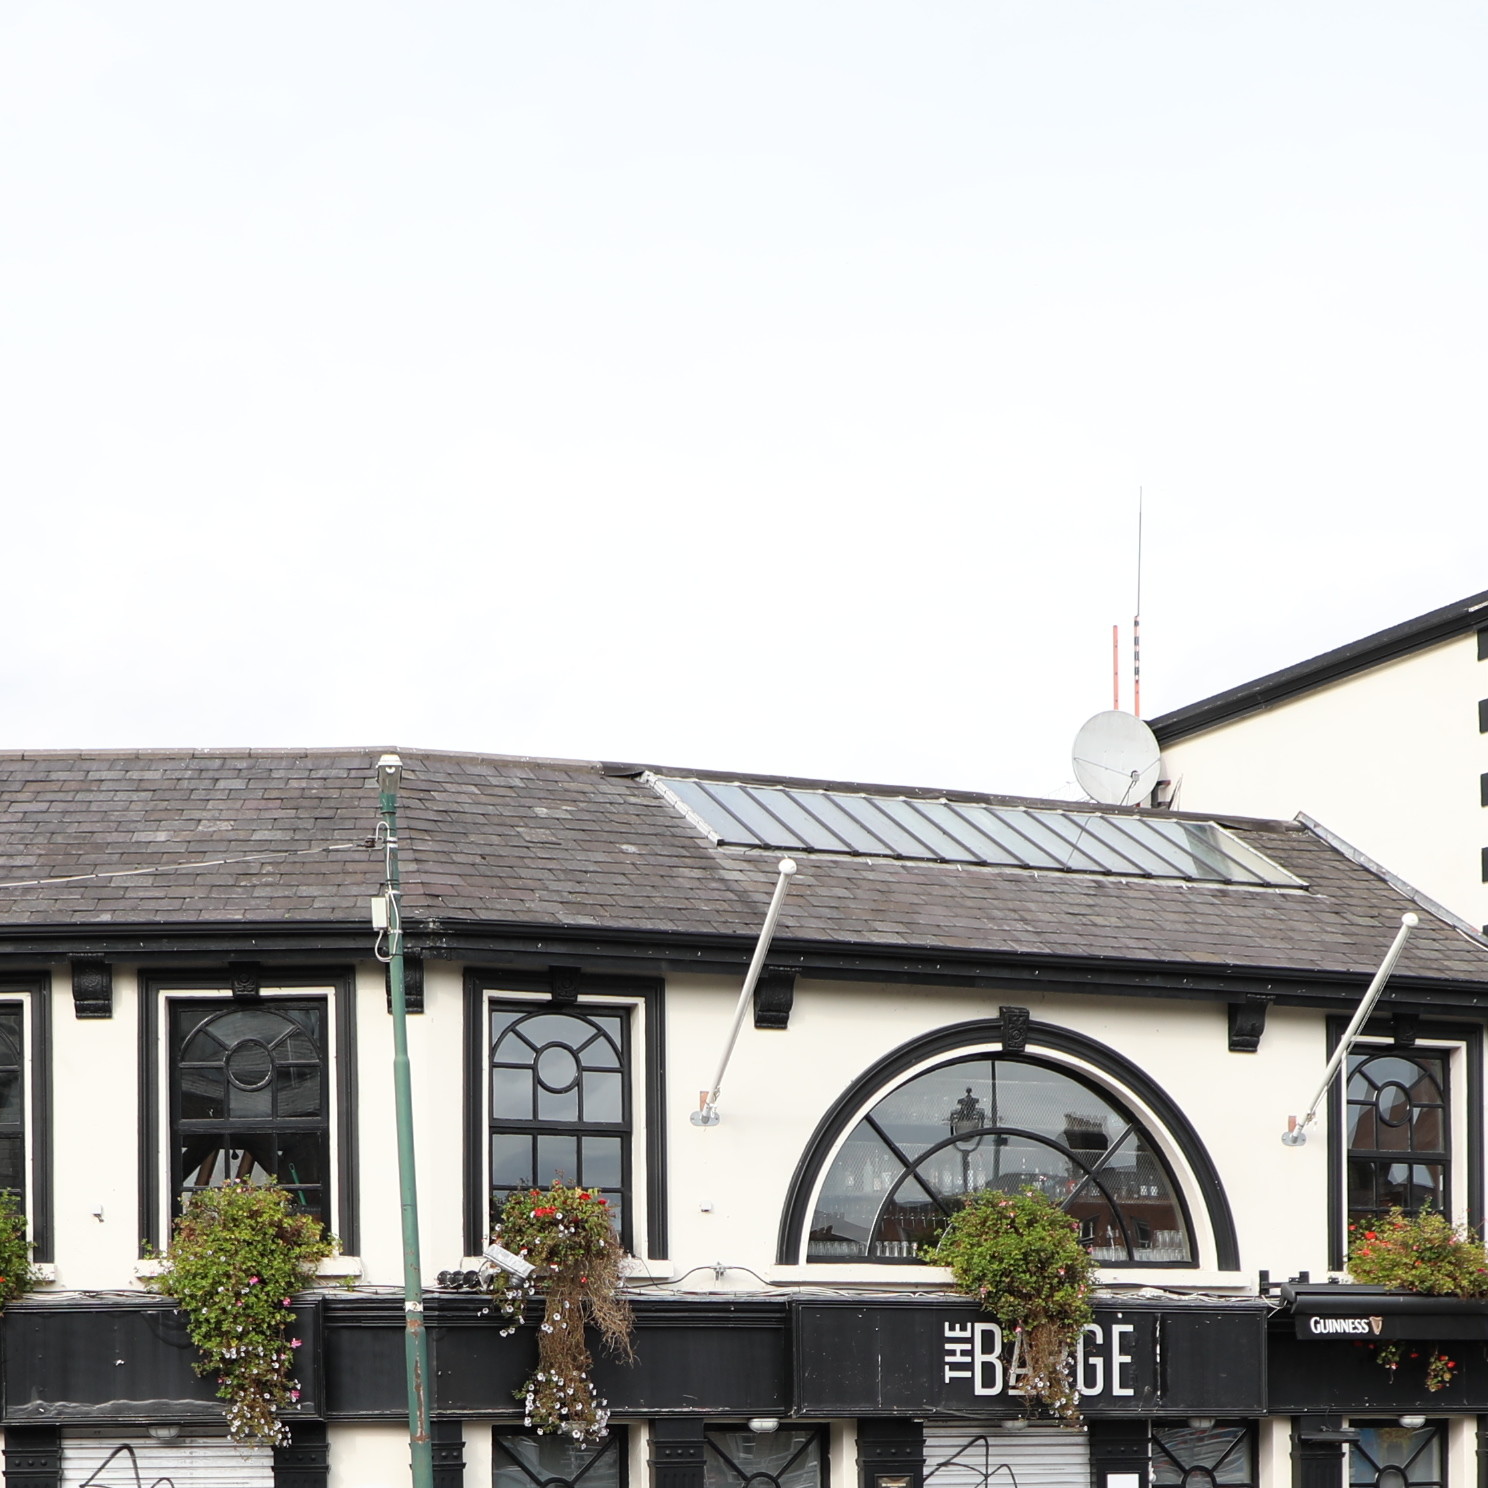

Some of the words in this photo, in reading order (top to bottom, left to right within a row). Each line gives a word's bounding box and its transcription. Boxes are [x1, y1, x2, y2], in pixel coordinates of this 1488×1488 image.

[1310, 1316, 1369, 1334] GUINNESS
[944, 1321, 972, 1384] THE
[974, 1322, 1135, 1396] BAGE
